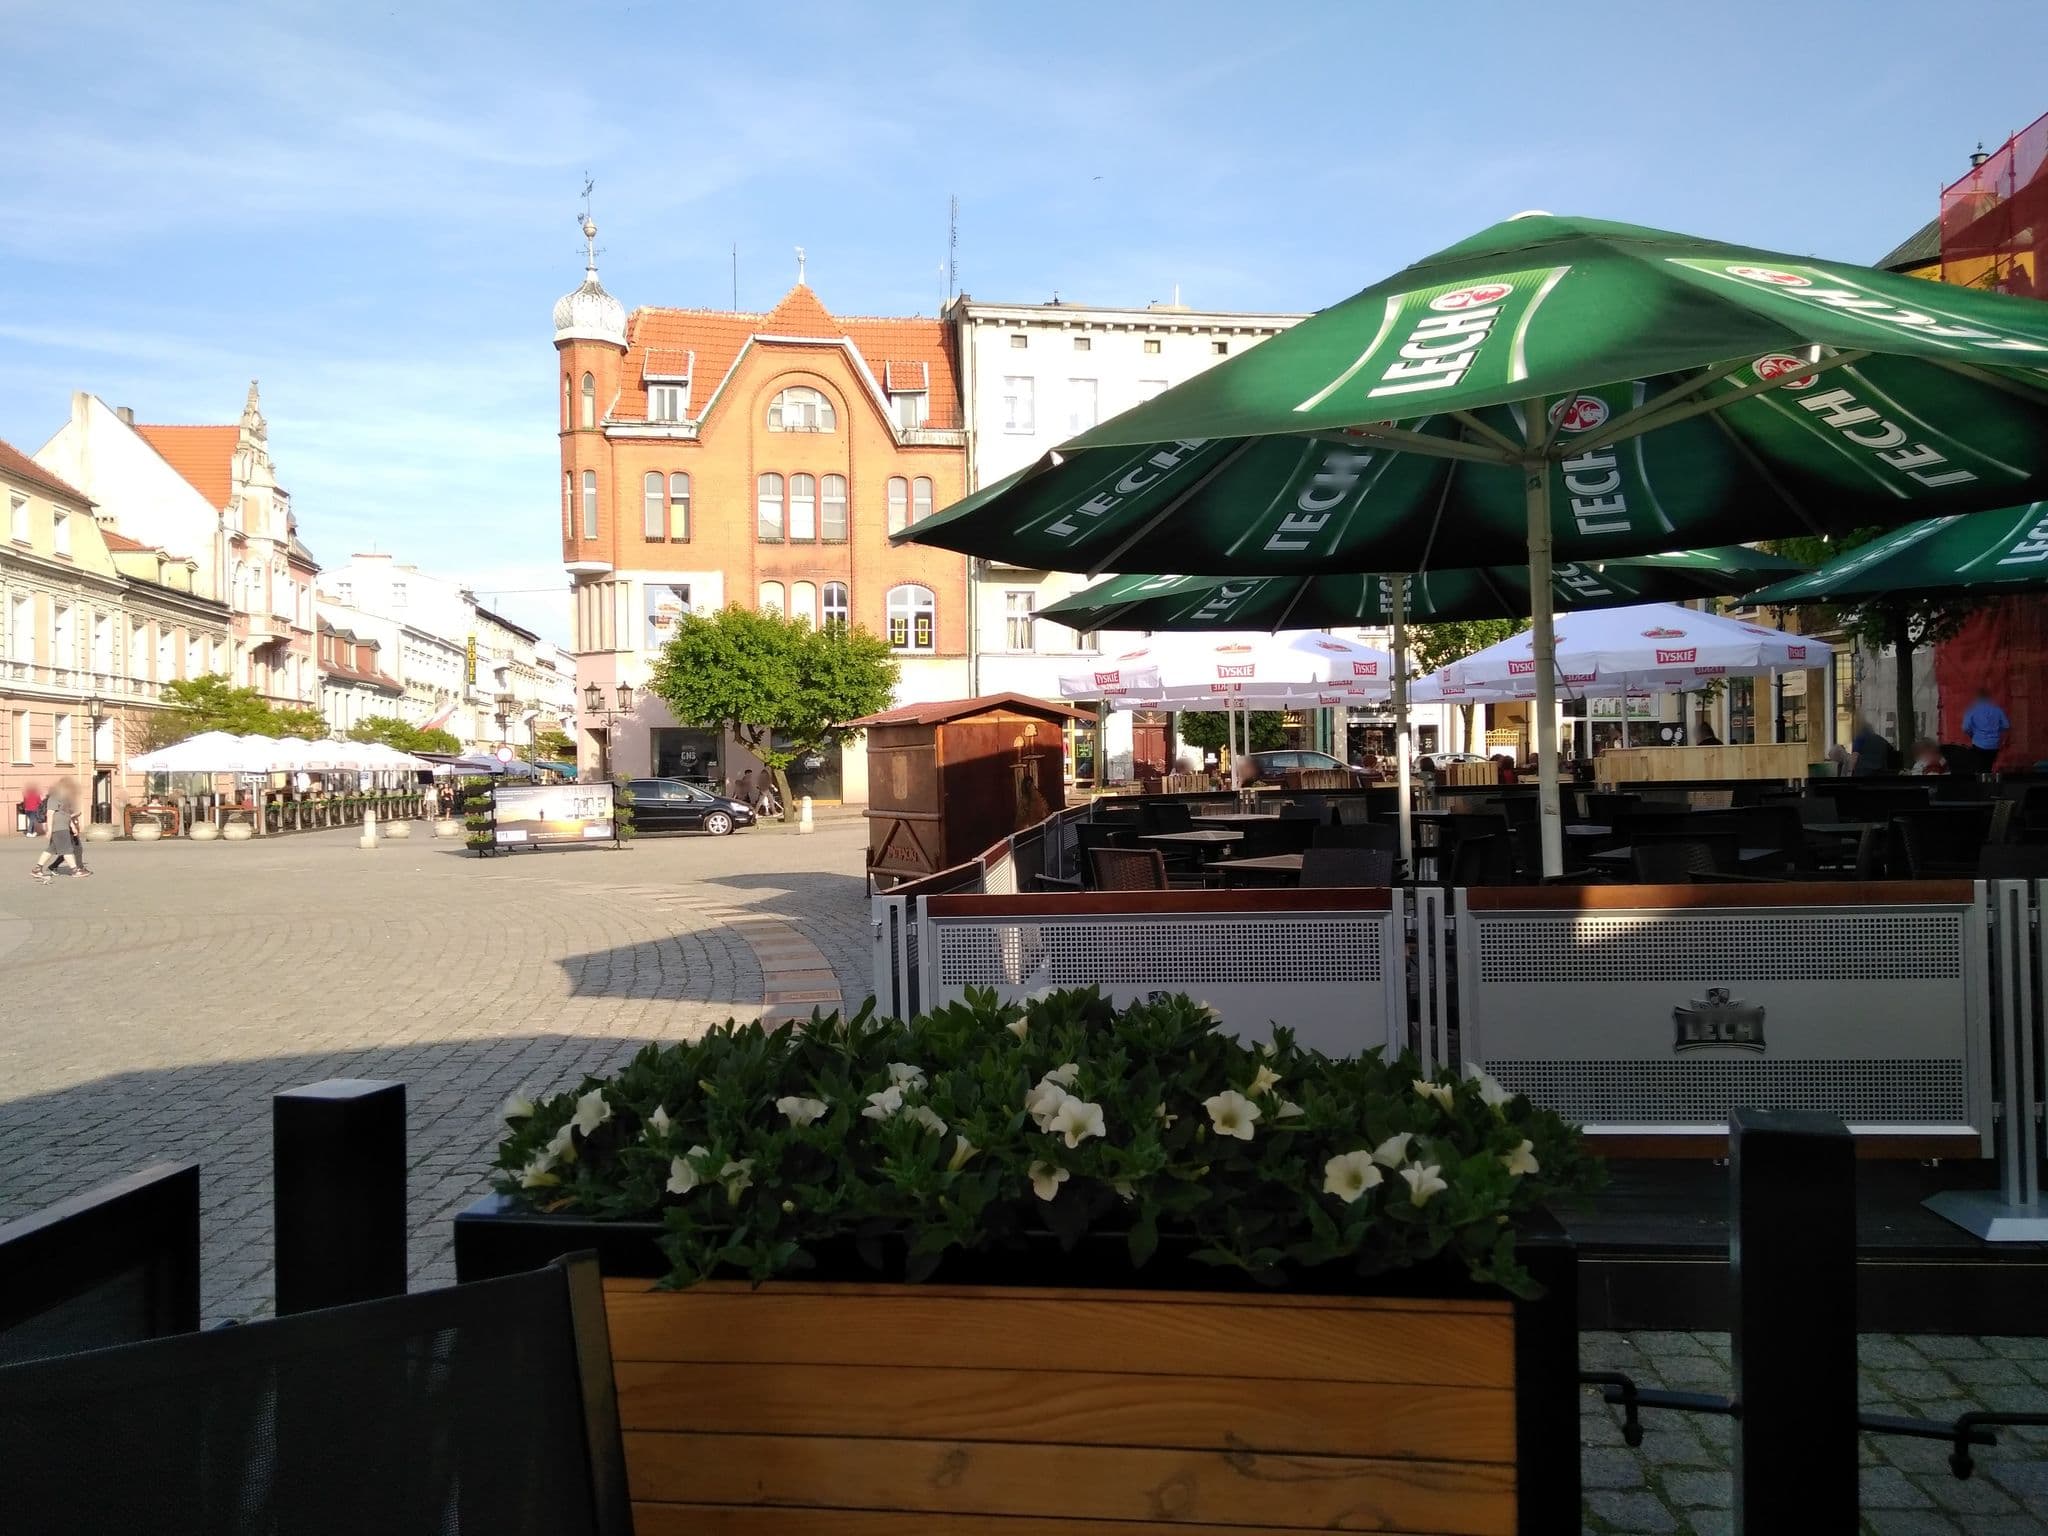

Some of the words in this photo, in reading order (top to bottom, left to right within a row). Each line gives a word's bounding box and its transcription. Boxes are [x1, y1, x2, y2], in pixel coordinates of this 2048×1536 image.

[1782, 286, 2048, 351] LECH
[1366, 304, 1504, 399] LECH
[1996, 513, 2048, 566] LE
[1659, 651, 1695, 662] TYSKIE
[1219, 665, 1254, 677] TYSKIE
[1354, 663, 1376, 674] TYSKIE
[1510, 662, 1535, 673] TYSKI
[1095, 672, 1119, 685] TYSKIE
